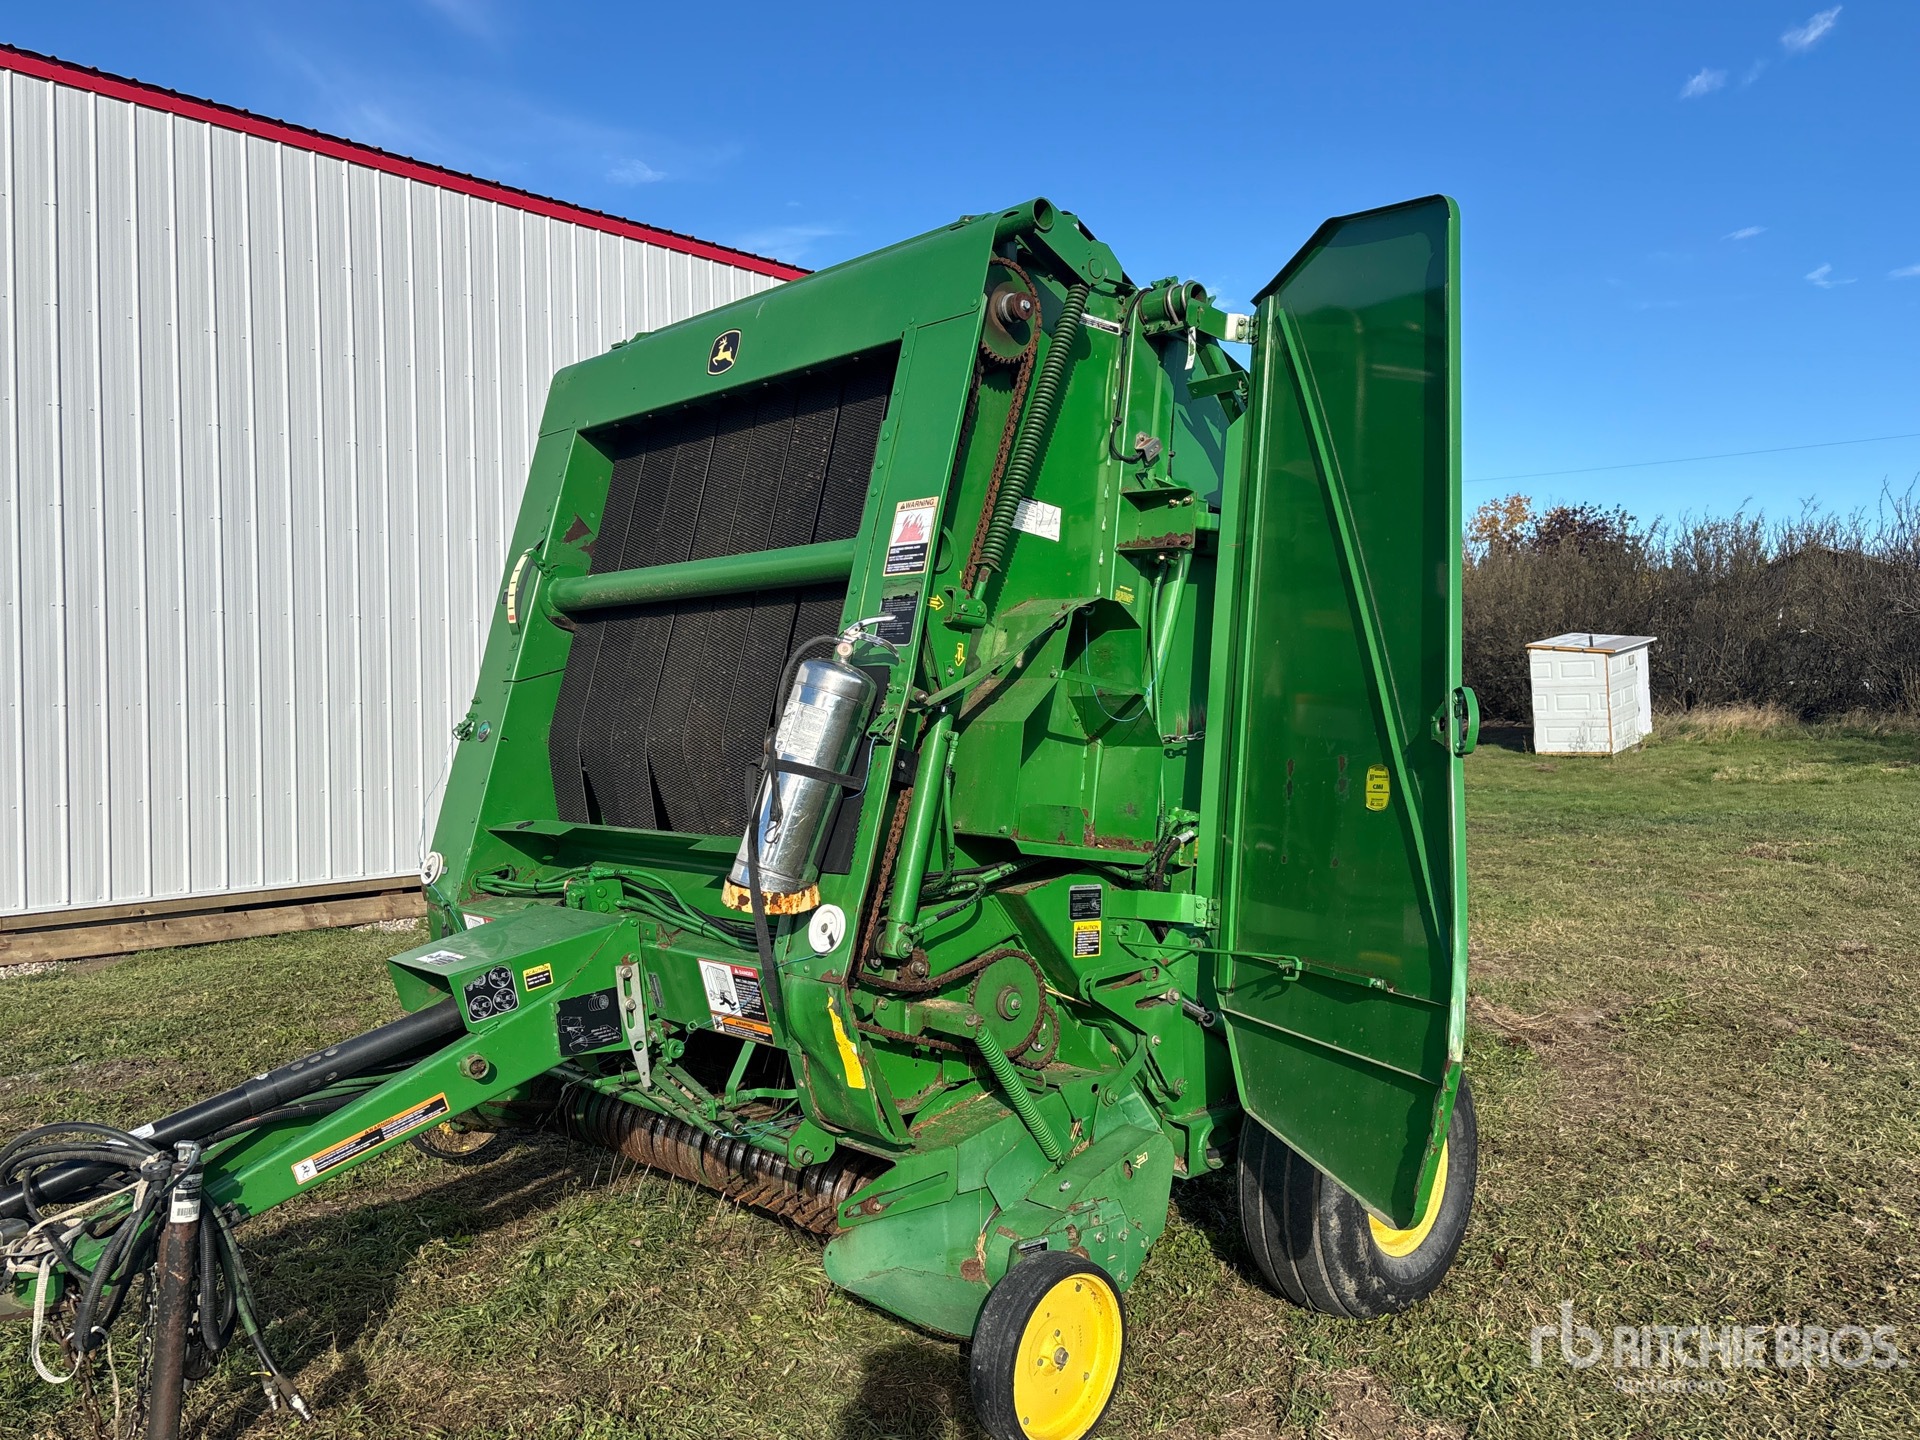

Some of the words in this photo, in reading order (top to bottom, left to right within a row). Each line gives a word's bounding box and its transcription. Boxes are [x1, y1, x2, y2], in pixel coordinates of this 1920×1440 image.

[905, 498, 935, 508] WARNING
[528, 965, 549, 974] CAUTION
[369, 1117, 394, 1132] WARNING
